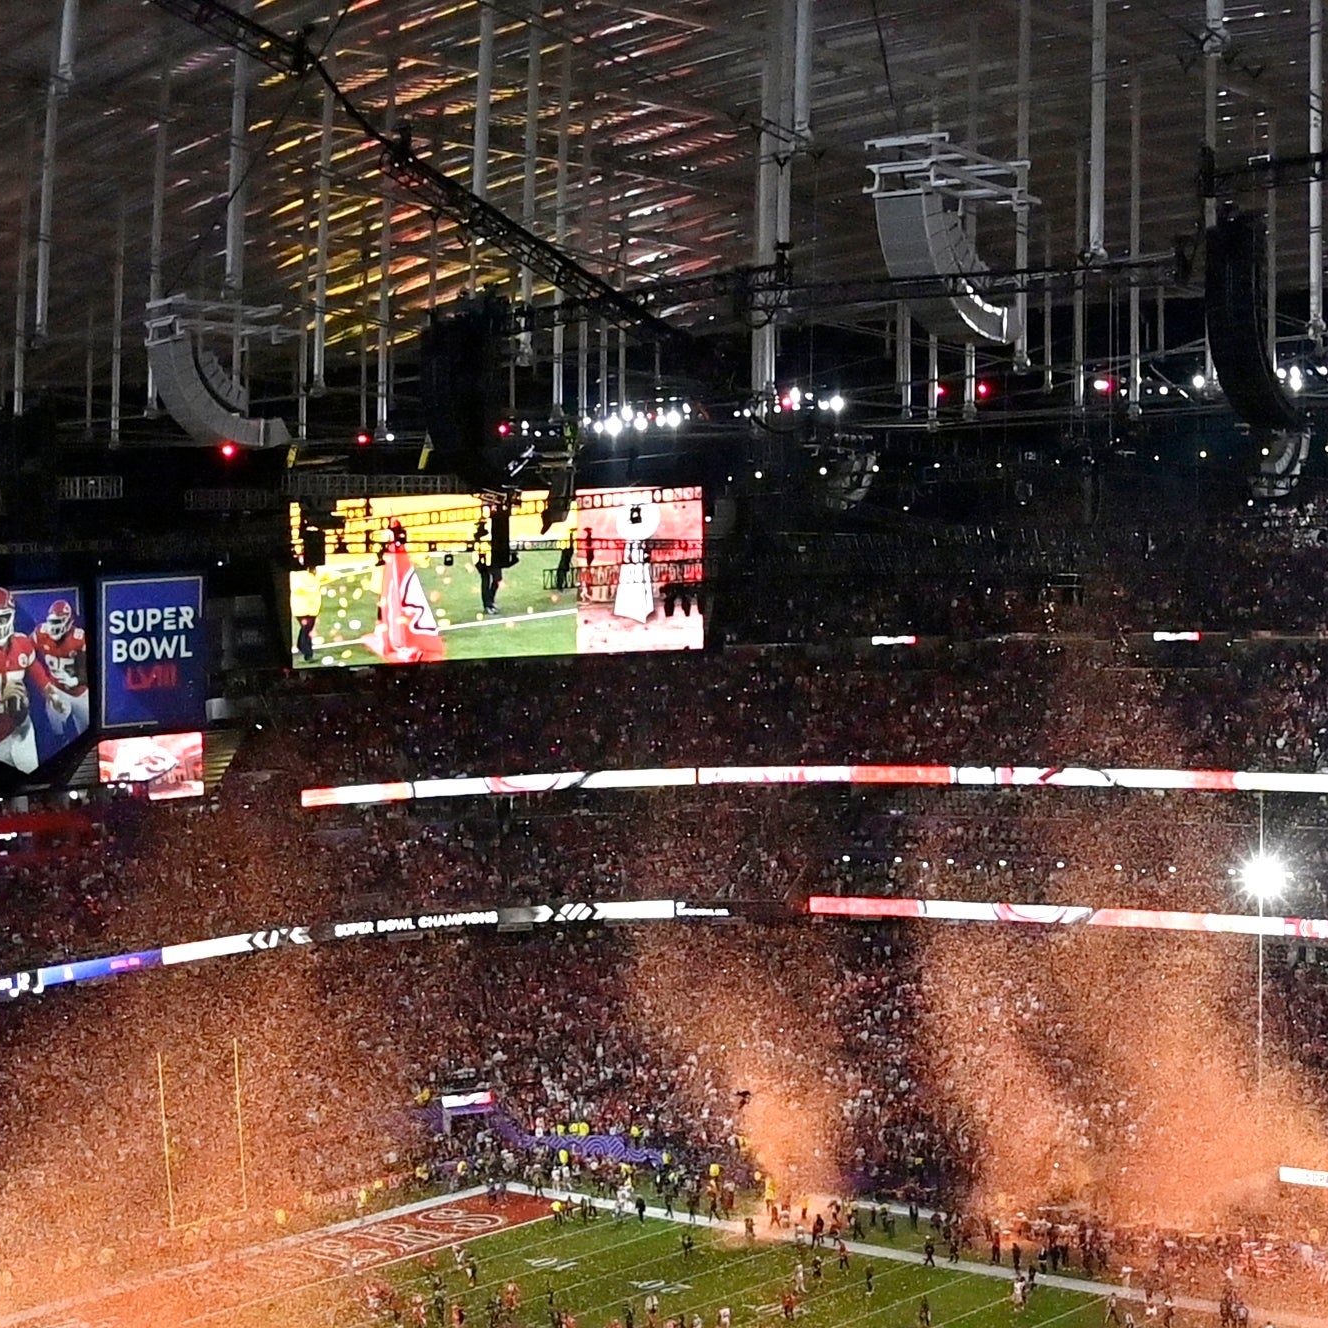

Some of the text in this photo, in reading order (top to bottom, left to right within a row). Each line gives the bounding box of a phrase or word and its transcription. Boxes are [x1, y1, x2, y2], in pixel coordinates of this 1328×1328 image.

[109, 606, 194, 635] SUPER
[112, 634, 193, 664] BOWL
[335, 911, 499, 937] SUPER BOWL CHAMPIONS
